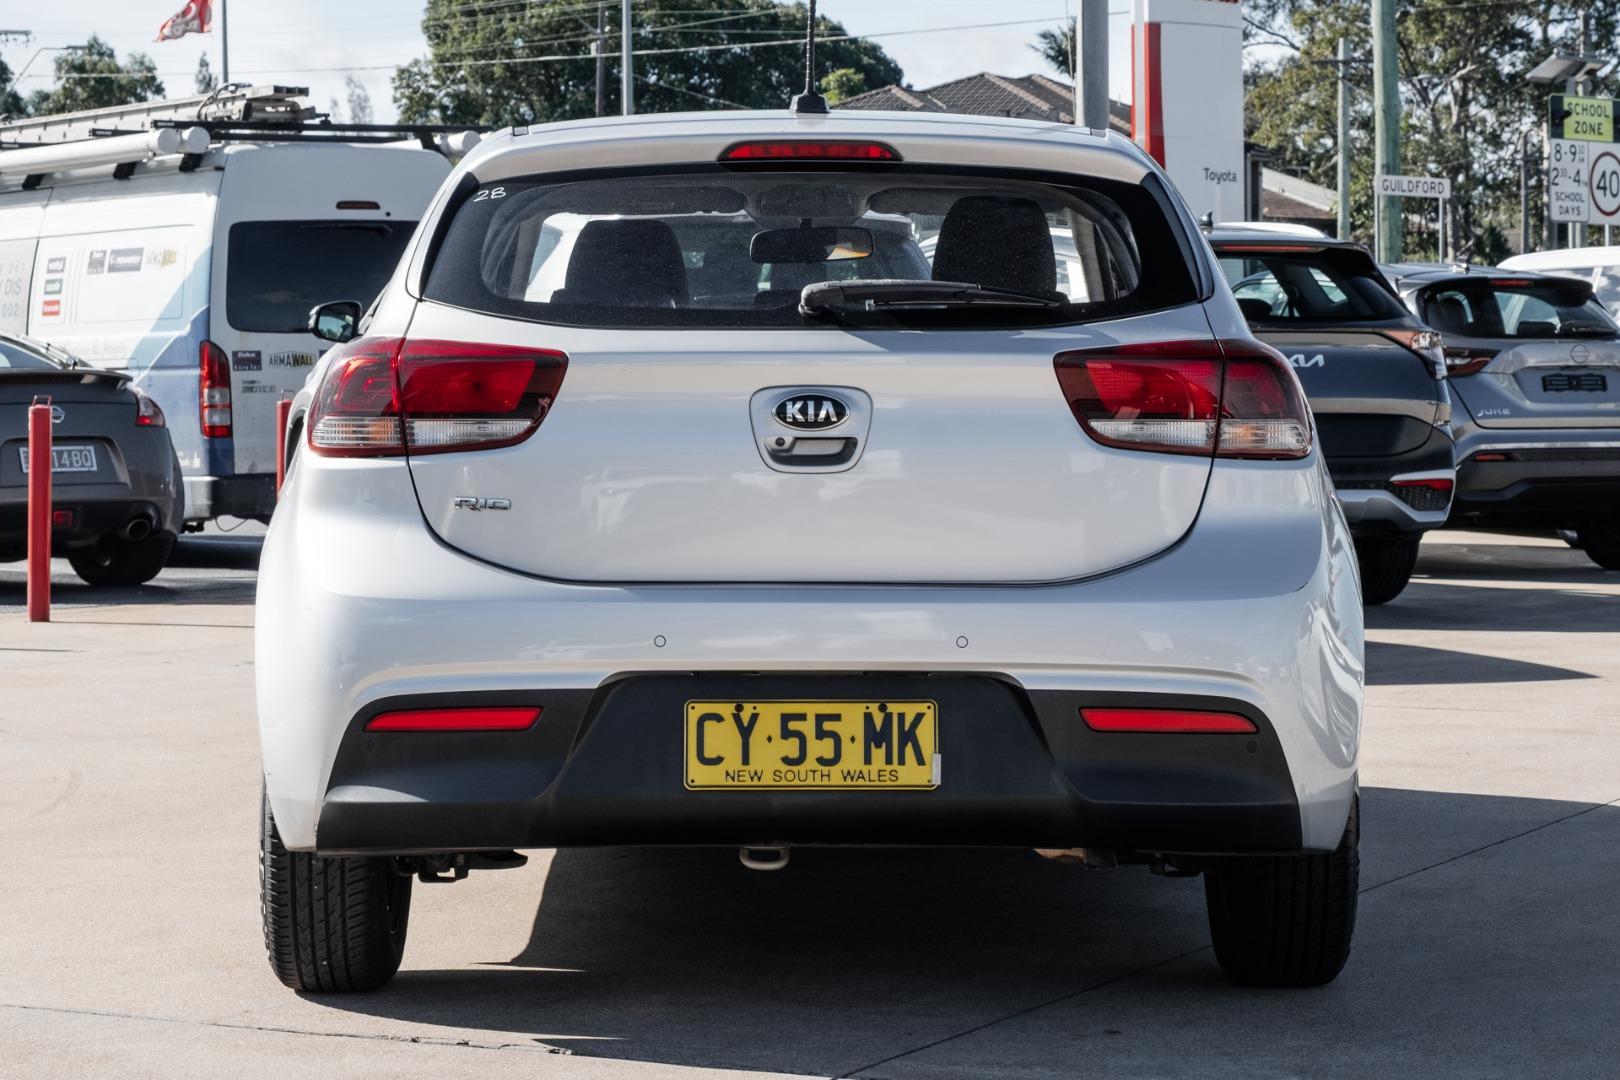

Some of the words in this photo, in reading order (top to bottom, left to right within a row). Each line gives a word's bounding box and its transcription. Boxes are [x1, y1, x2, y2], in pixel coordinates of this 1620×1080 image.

[1567, 102, 1610, 119] SCHOOL
[1574, 120, 1604, 136] ZONE
[1203, 167, 1237, 185] Toyota
[1595, 169, 1620, 199] 40
[1382, 178, 1445, 194] GUILDFORD
[1555, 191, 1585, 204] SCHOOL
[1558, 204, 1582, 216] DAYS
[785, 400, 838, 422] KIA
[1477, 408, 1511, 417] JUKE
[454, 496, 512, 511] RIO
[725, 769, 763, 783] NEW
[773, 769, 831, 783] SOUTH
[842, 769, 899, 783] WALES
